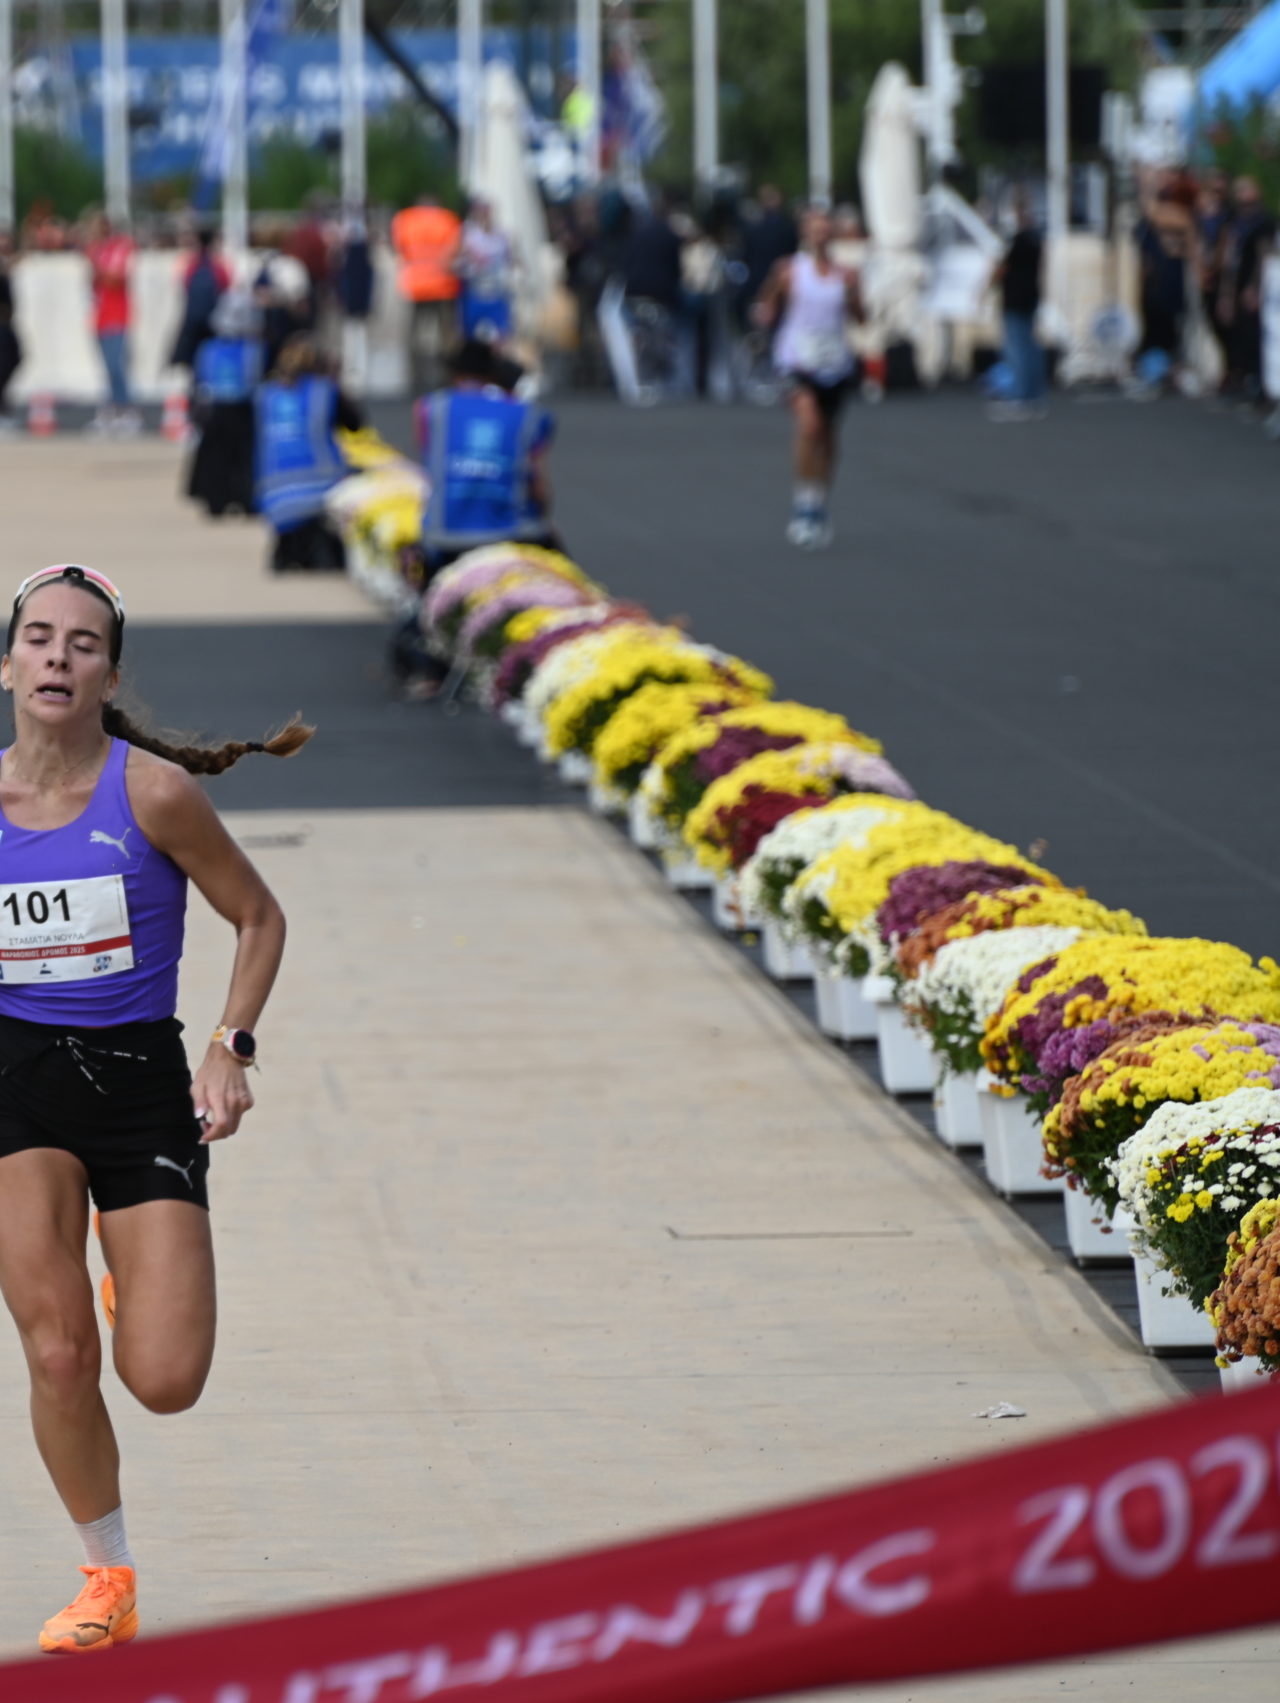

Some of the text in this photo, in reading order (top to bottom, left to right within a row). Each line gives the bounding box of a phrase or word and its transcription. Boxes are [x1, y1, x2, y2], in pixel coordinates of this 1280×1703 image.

[3, 888, 70, 926] 101
[144, 1432, 1280, 1703] THENTIC 202
